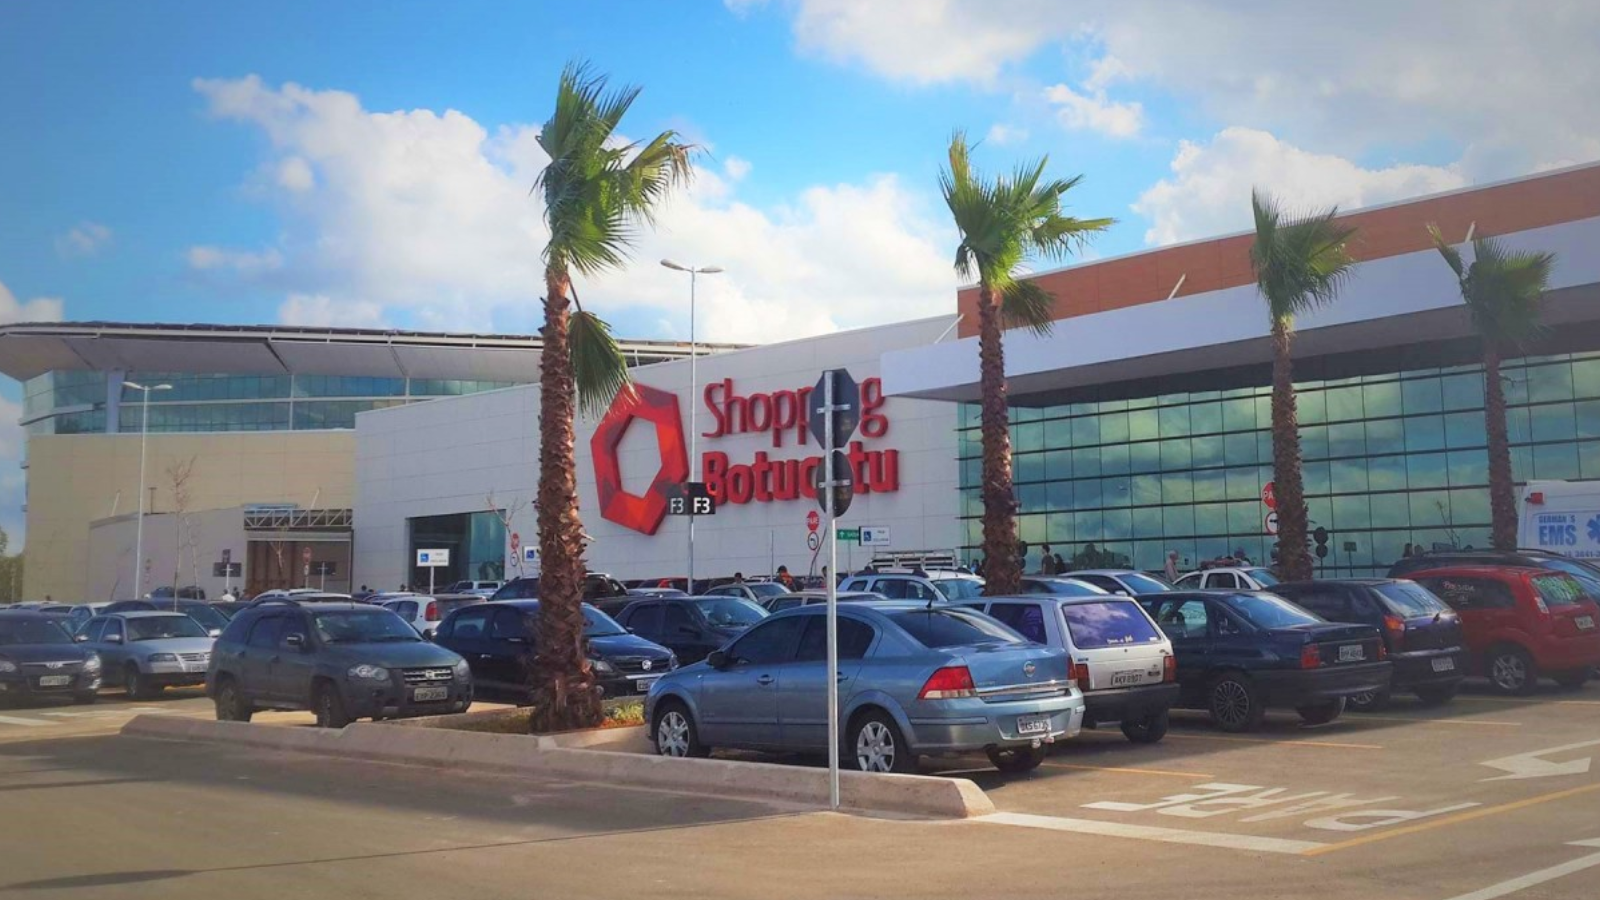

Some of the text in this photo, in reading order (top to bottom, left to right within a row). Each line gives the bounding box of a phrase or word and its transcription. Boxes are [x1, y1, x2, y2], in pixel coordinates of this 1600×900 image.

[702, 377, 889, 447] Shoppg
[702, 441, 900, 506] Botuctu
[670, 497, 684, 514] F3
[693, 497, 710, 514] F3
[1539, 524, 1577, 546] EMS
